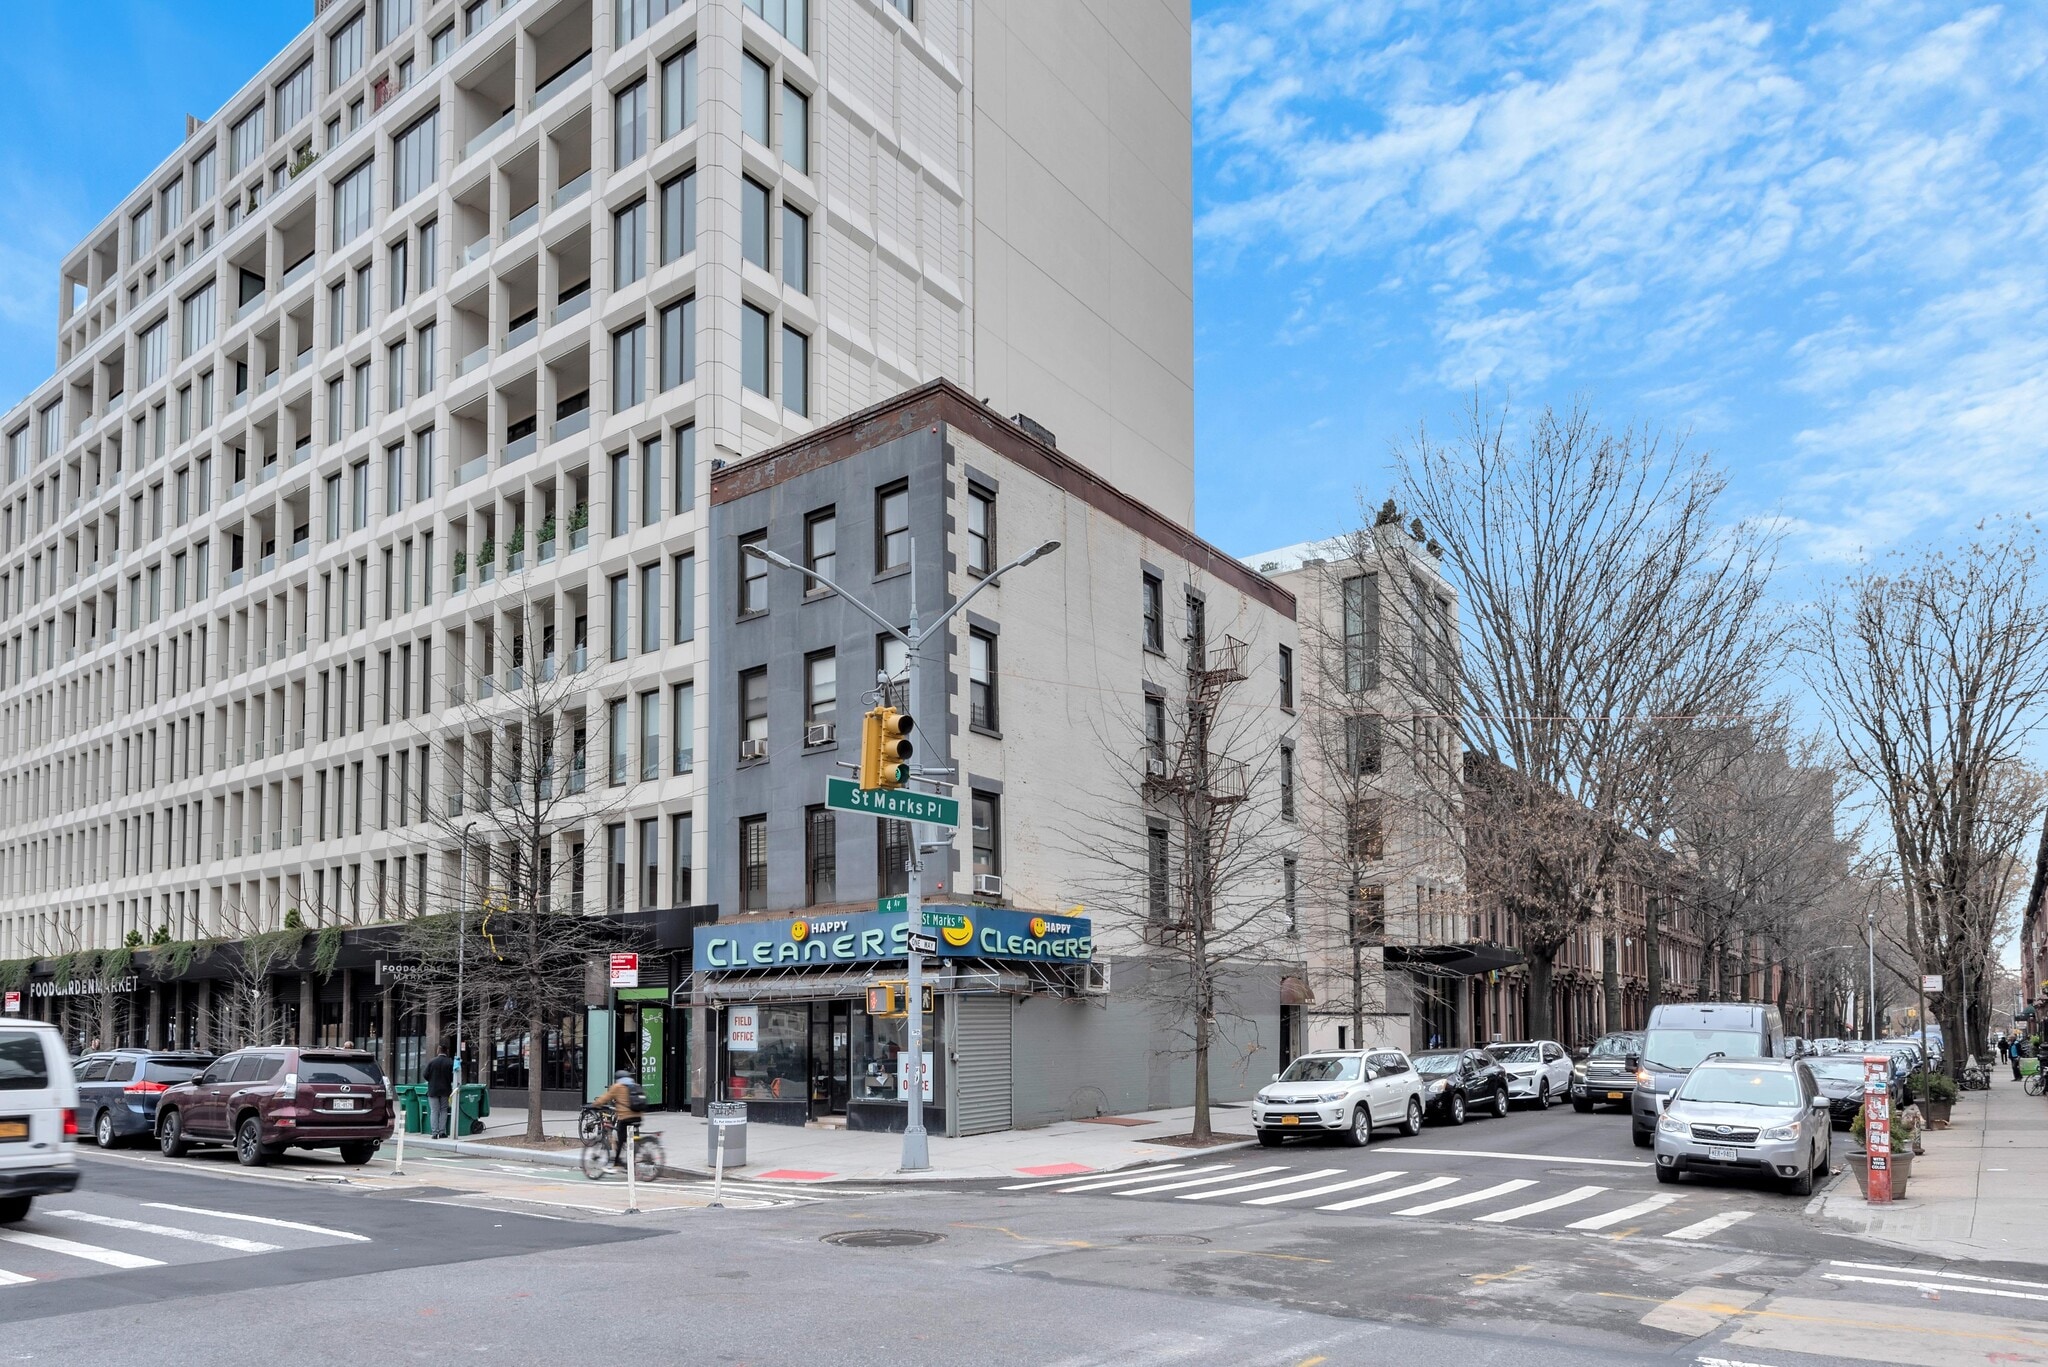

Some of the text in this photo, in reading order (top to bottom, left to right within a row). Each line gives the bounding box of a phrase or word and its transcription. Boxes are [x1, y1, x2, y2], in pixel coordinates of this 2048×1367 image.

[851, 788, 942, 818] St Marks Pl
[886, 900, 892, 911] 4
[922, 913, 930, 925] St
[932, 914, 956, 927] Marks
[811, 920, 848, 934] HAPPY
[1044, 921, 1071, 934] HAPPY
[707, 921, 910, 967] CLEANERS
[912, 939, 934, 950] ONE WAY
[980, 927, 1092, 959] CLEANERS
[734, 1016, 752, 1026] FIELD
[732, 1031, 755, 1041] OFFICE
[642, 1056, 656, 1066] OD
[642, 1073, 656, 1081] KET
